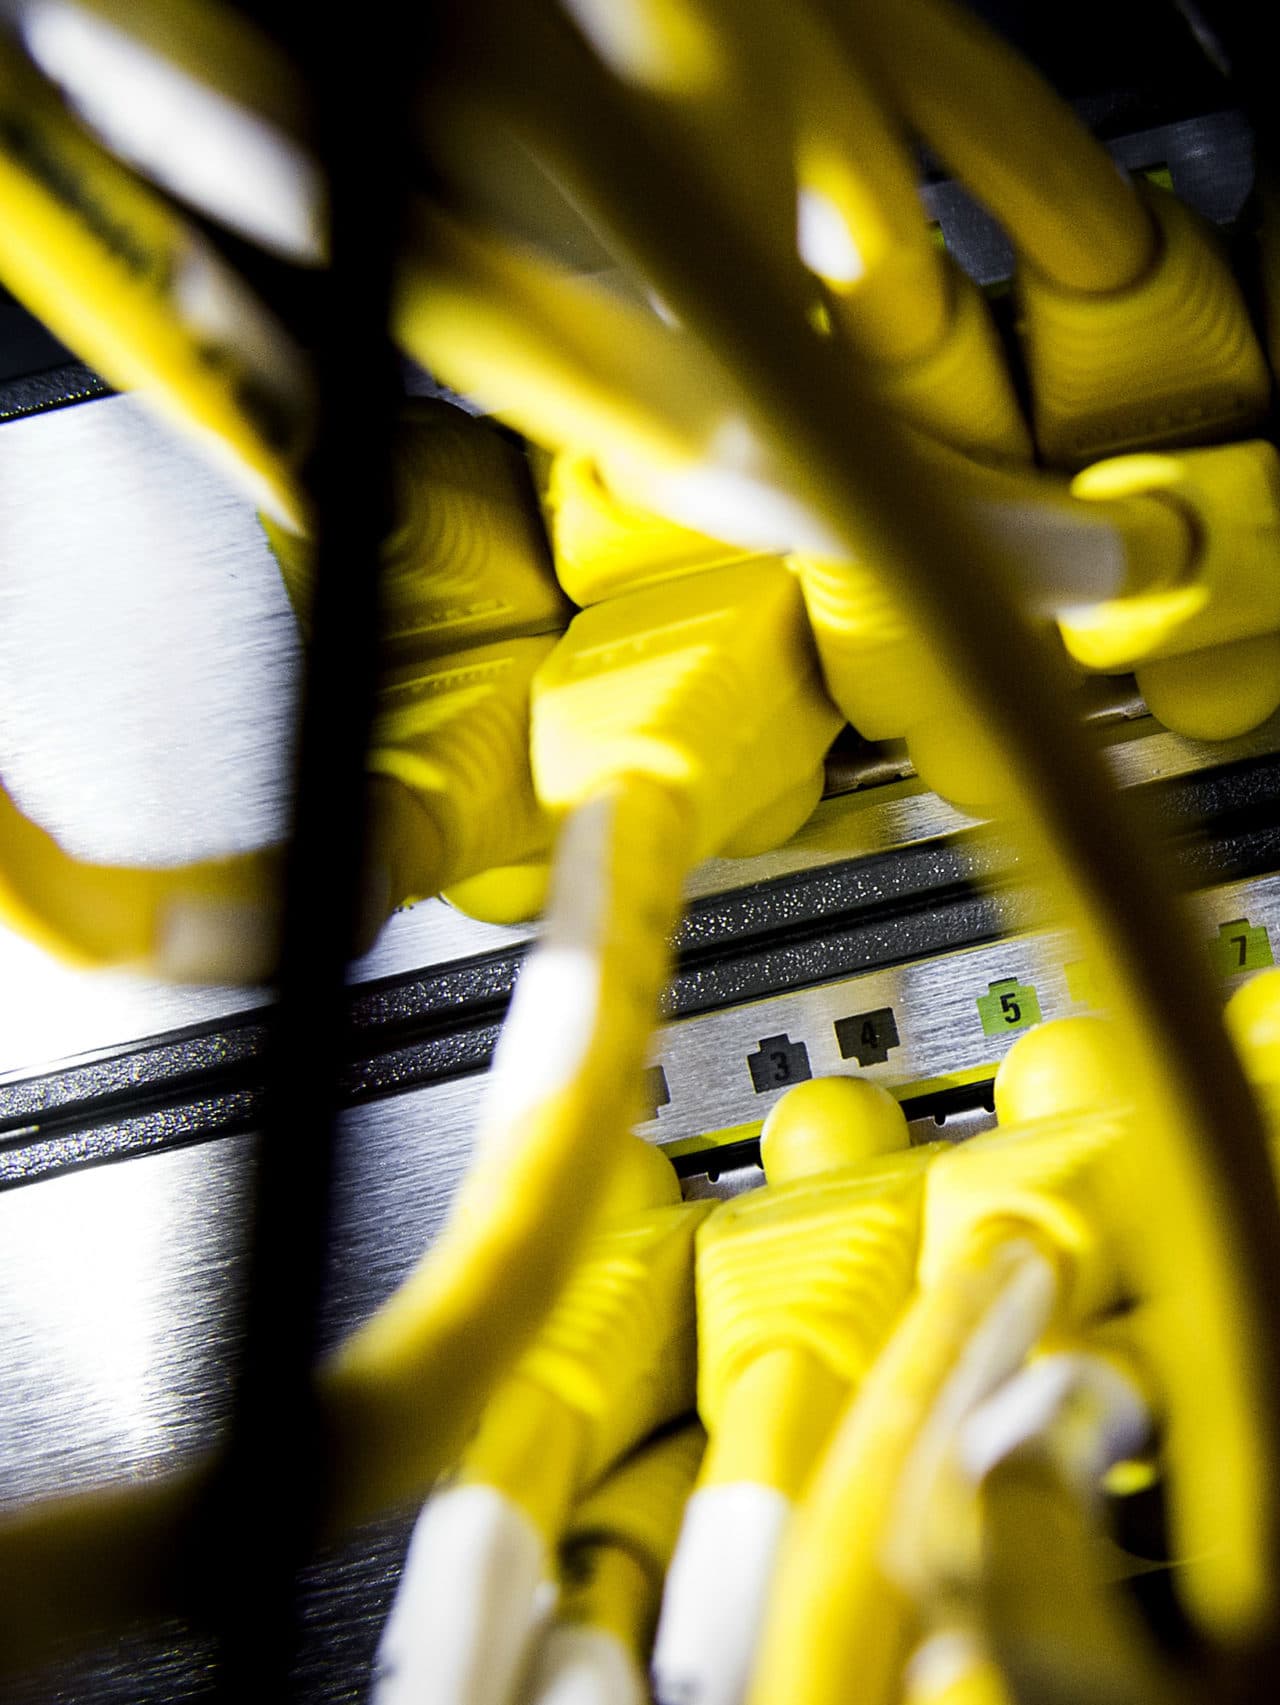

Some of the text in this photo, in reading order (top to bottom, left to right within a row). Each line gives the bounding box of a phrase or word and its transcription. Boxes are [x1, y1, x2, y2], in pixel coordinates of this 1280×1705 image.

[1230, 935, 1247, 965] 7
[999, 992, 1022, 1023] 5
[860, 1021, 879, 1050] 4
[770, 1050, 791, 1082] 3
